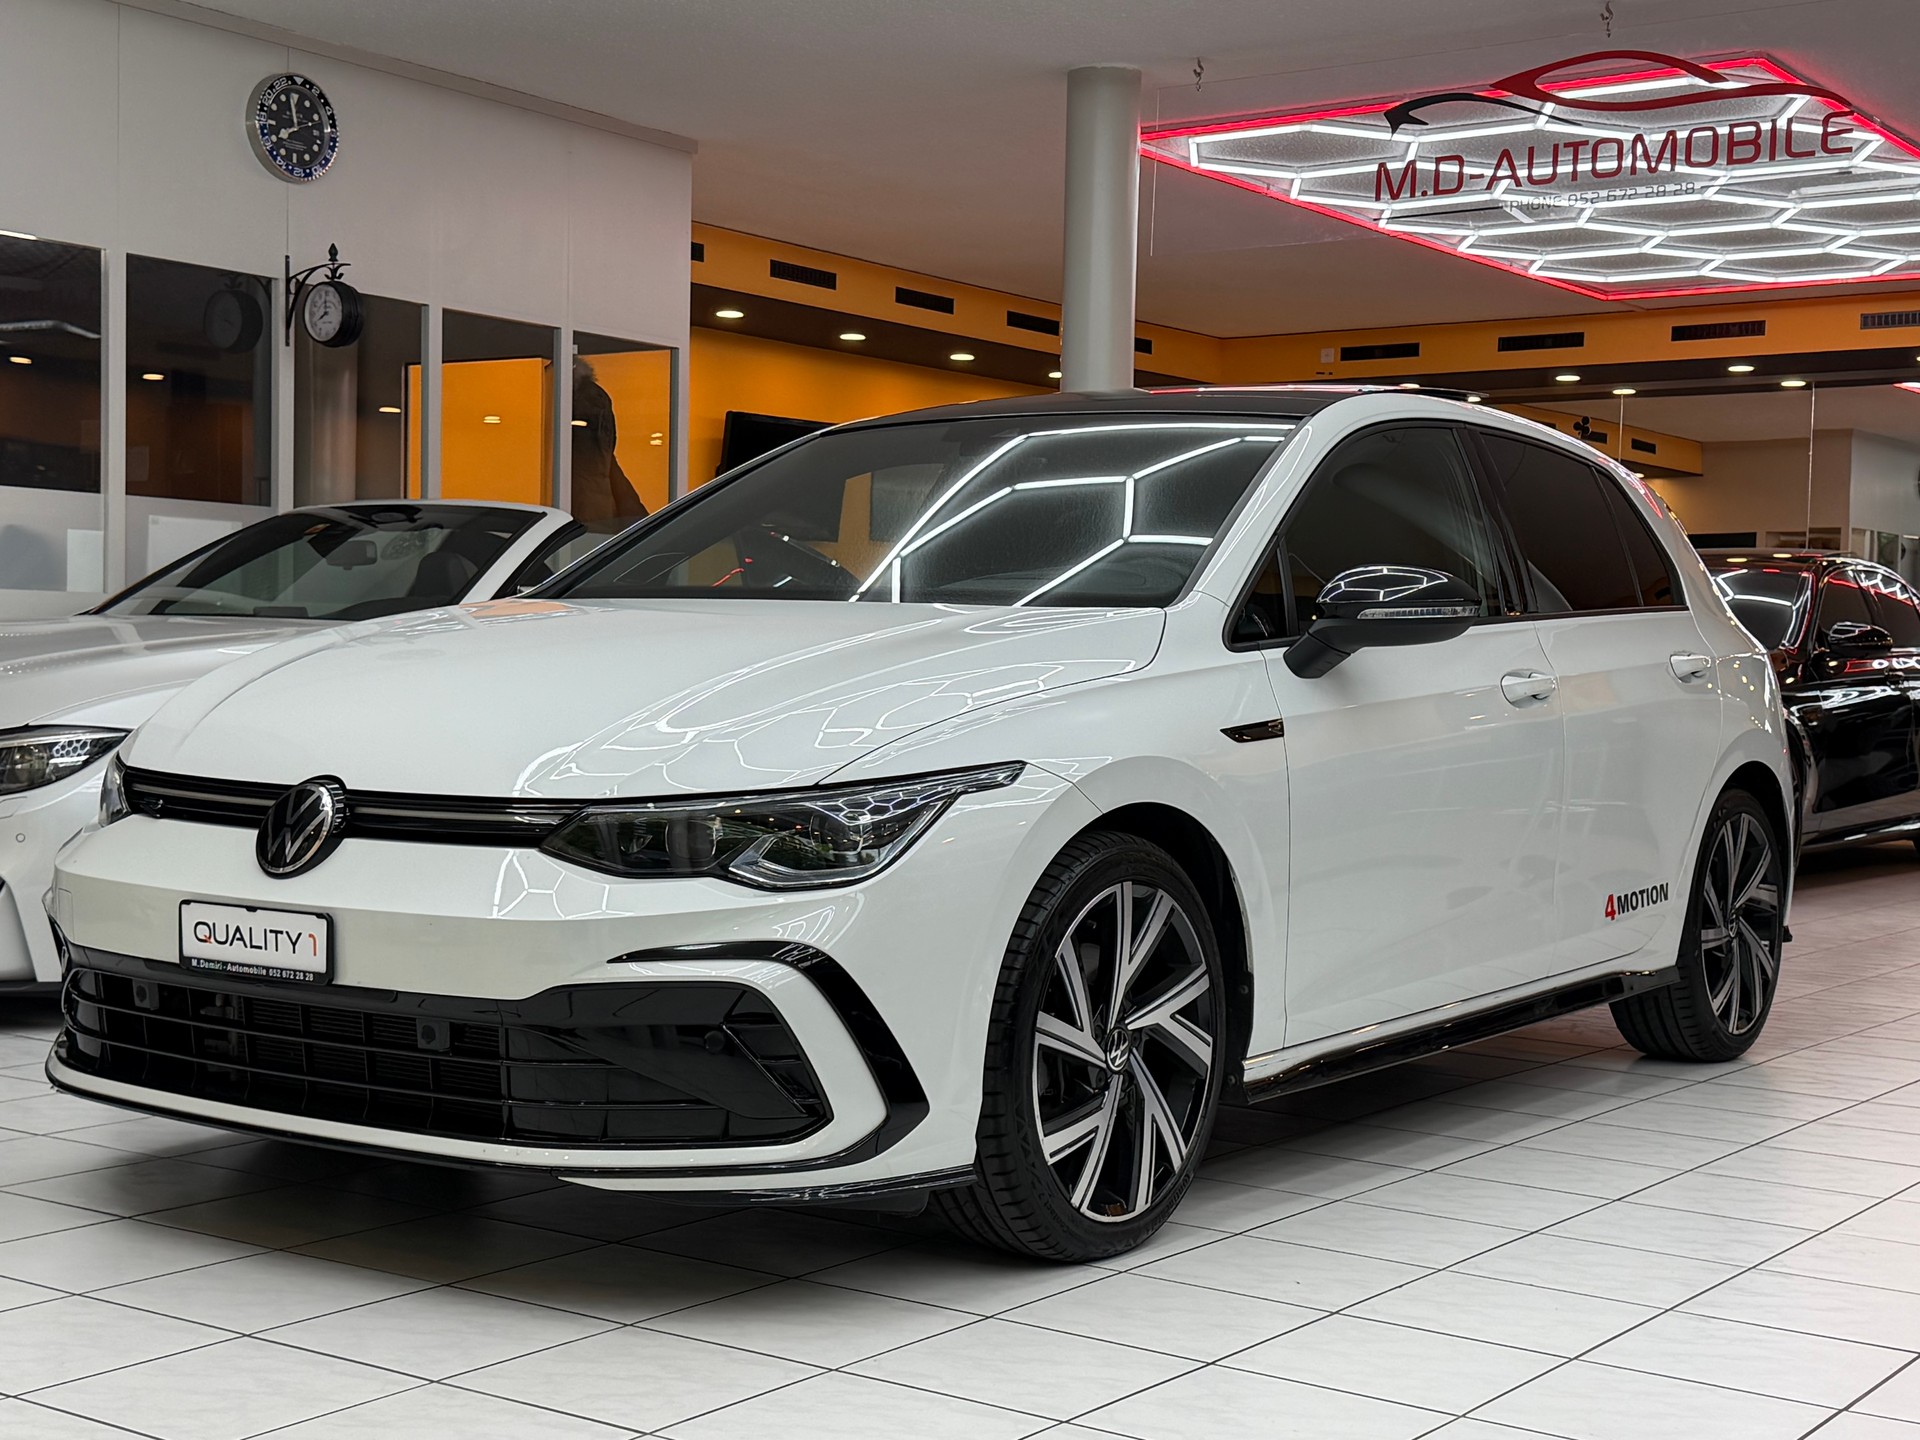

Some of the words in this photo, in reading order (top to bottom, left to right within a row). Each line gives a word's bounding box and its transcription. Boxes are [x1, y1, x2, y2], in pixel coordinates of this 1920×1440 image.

[1374, 110, 1855, 202] M.D-AUTOMOBILE
[1509, 194, 1562, 212] PHONE
[1606, 187, 1638, 202] 672
[1644, 184, 1667, 198] 28
[1673, 181, 1696, 196] 28
[1604, 882, 1669, 921] 4MOTION
[193, 920, 303, 955] QUALITY
[308, 933, 318, 957] 1
[226, 962, 267, 976] Automobile
